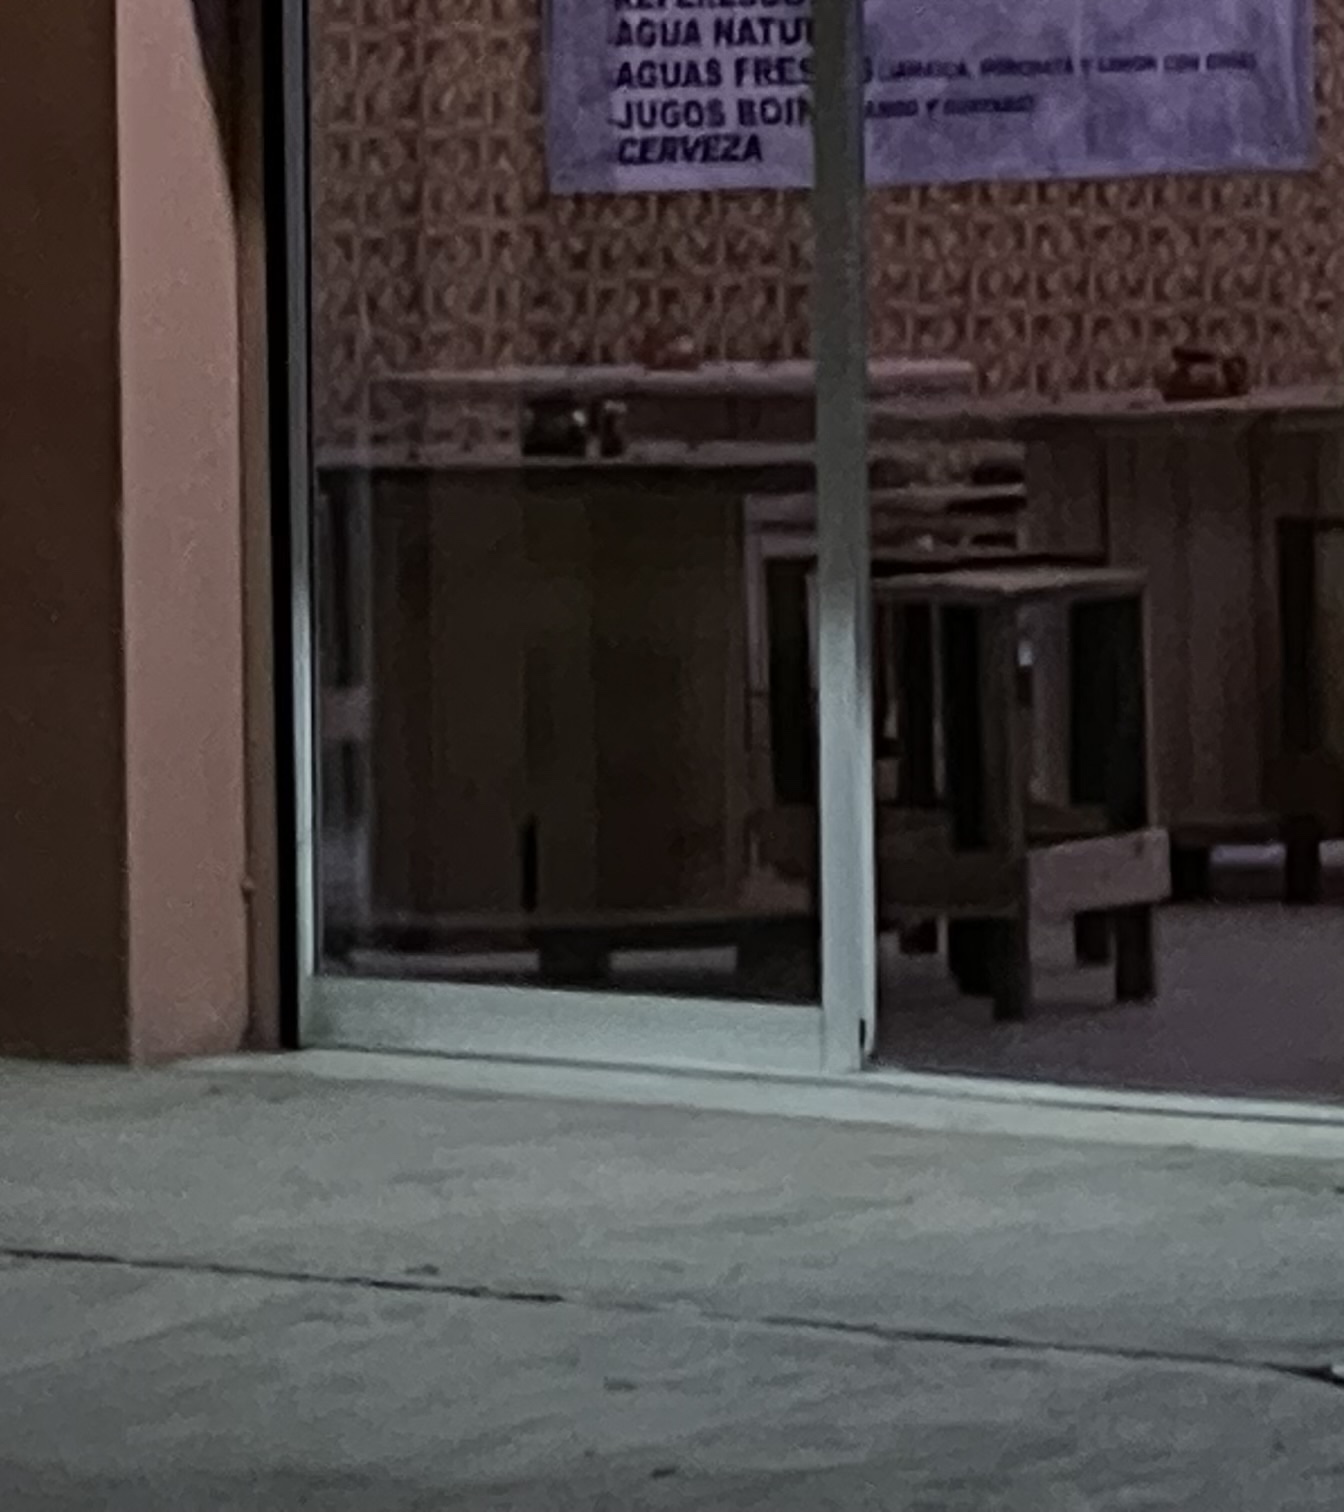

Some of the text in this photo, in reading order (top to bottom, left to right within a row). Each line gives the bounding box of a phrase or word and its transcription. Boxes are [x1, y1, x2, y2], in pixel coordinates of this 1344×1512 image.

[613, 17, 814, 48] AGUA NATU
[614, 57, 723, 89] AGUAS
[611, 96, 726, 129] JUGOS
[617, 135, 763, 165] CERVEZA
